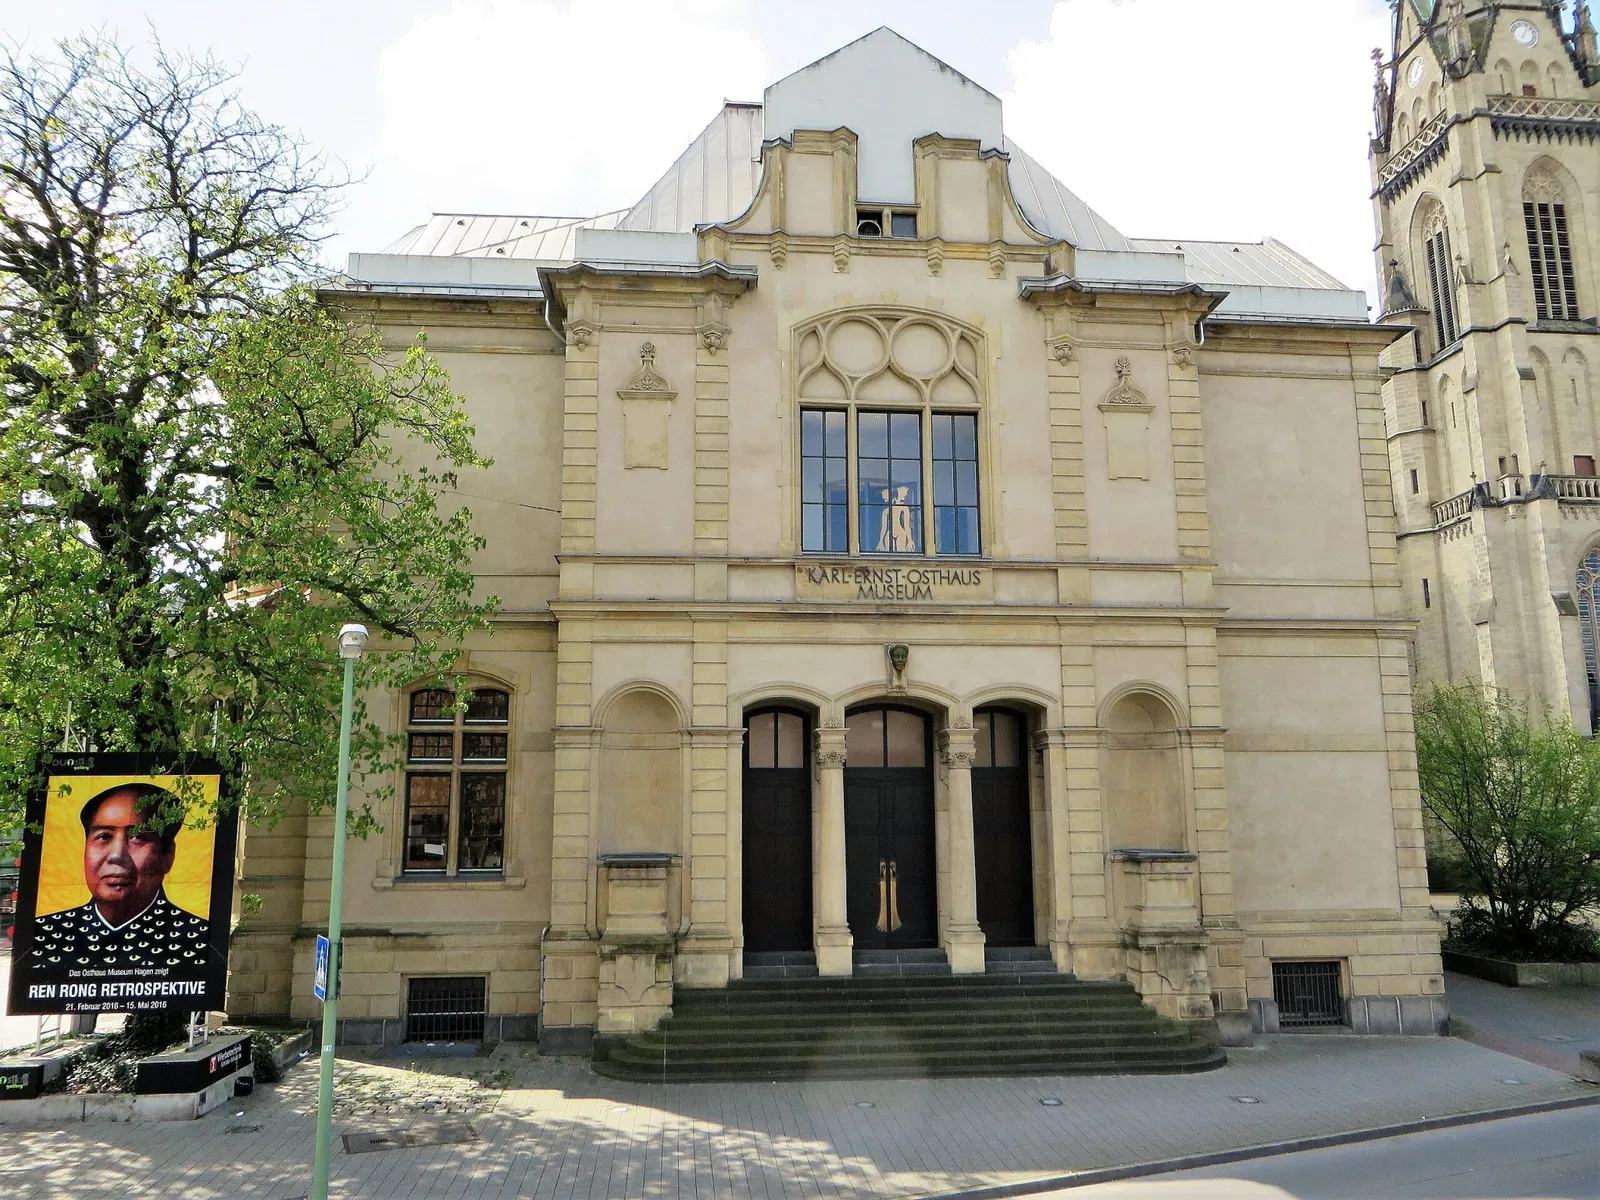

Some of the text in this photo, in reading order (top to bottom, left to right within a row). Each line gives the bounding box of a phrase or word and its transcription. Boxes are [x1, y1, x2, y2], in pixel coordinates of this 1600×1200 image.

[807, 566, 981, 586] KARL-ERNST-OSTHAUS
[857, 584, 933, 601] MUSEUM
[69, 967, 169, 978] Das Osthaus Museum Hagen zeigt
[28, 981, 206, 999] REN RONG RETROSPEKTIVE
[65, 1003, 76, 1011] 21.
[77, 1002, 101, 1011] Februar
[102, 1002, 119, 1010] 2016
[126, 1001, 137, 1009] 15.
[137, 1001, 150, 1009] Mai
[150, 1000, 167, 1009] 2016
